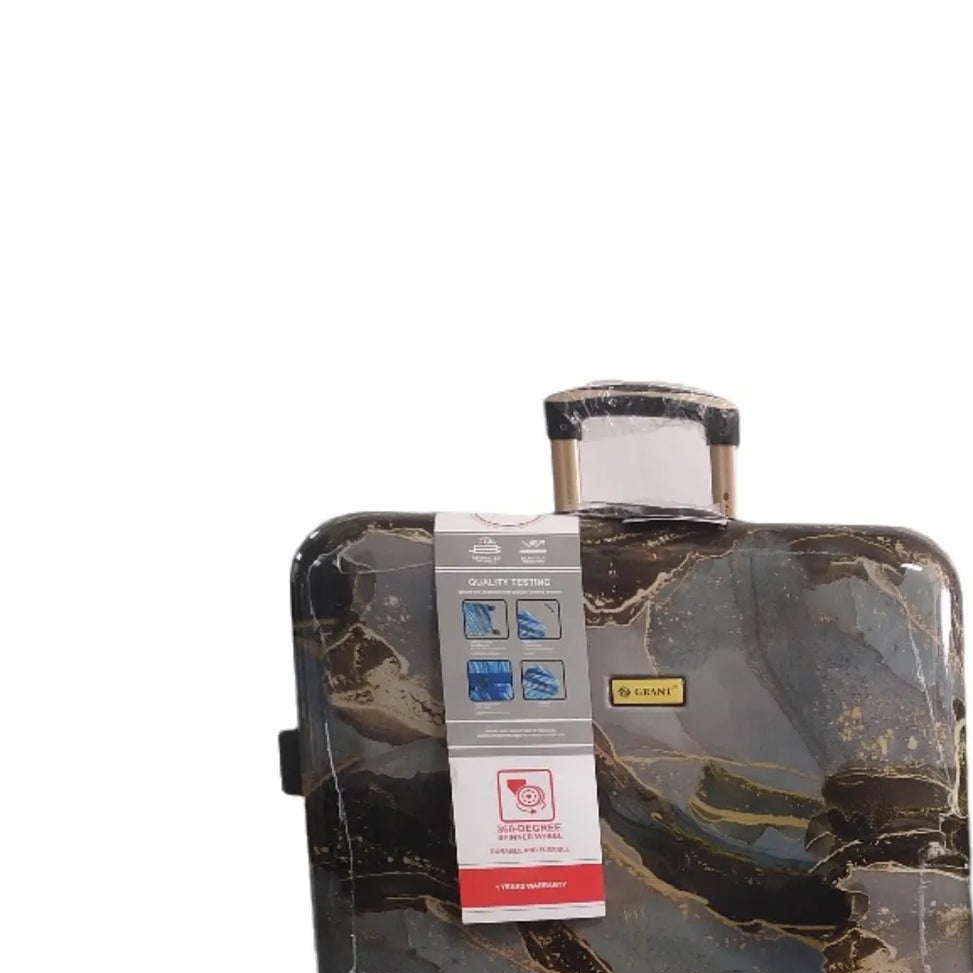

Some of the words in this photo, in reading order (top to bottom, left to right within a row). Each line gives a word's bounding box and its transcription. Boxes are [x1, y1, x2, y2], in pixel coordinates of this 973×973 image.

[468, 578, 508, 587] QUALITY
[510, 578, 551, 587] TESTING
[634, 687, 672, 696] GRANT
